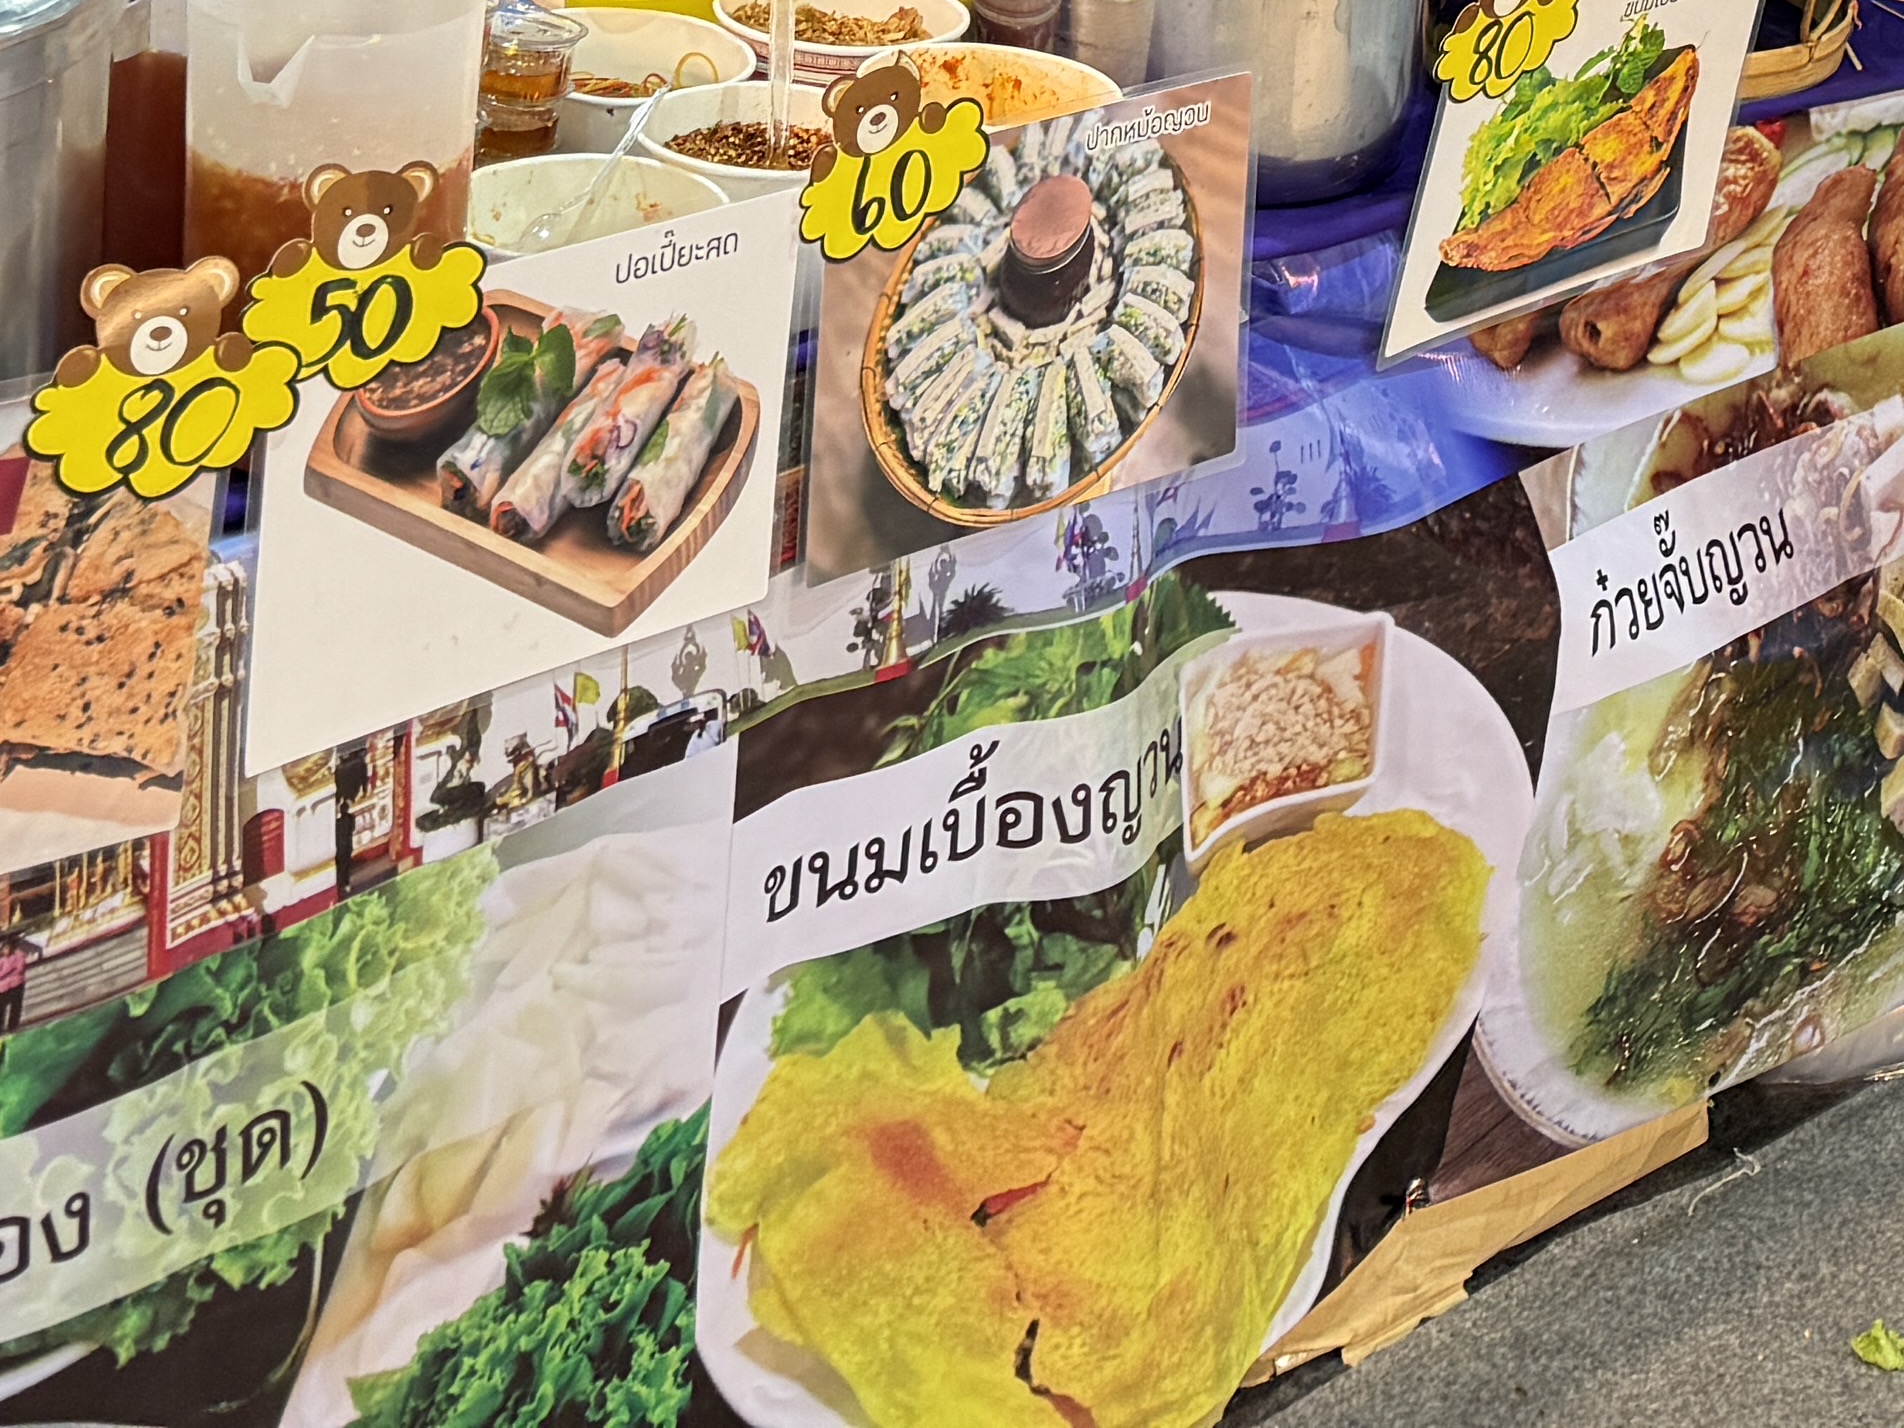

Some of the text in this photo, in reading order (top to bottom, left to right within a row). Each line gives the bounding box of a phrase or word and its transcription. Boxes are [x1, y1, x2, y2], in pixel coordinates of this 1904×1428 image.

[1468, 11, 1537, 87] 80
[1085, 99, 1211, 153] ปากหม้อญวน
[851, 148, 932, 237] 60
[614, 228, 740, 284] ปอเปี๊ยะสด
[308, 277, 413, 353] 50
[106, 378, 240, 475] 80
[1590, 508, 1794, 657] ก๋วยจั๊บญวน
[764, 715, 1185, 922] ขนมเบื้องญวน
[146, 1081, 330, 1236] (ชุด)
